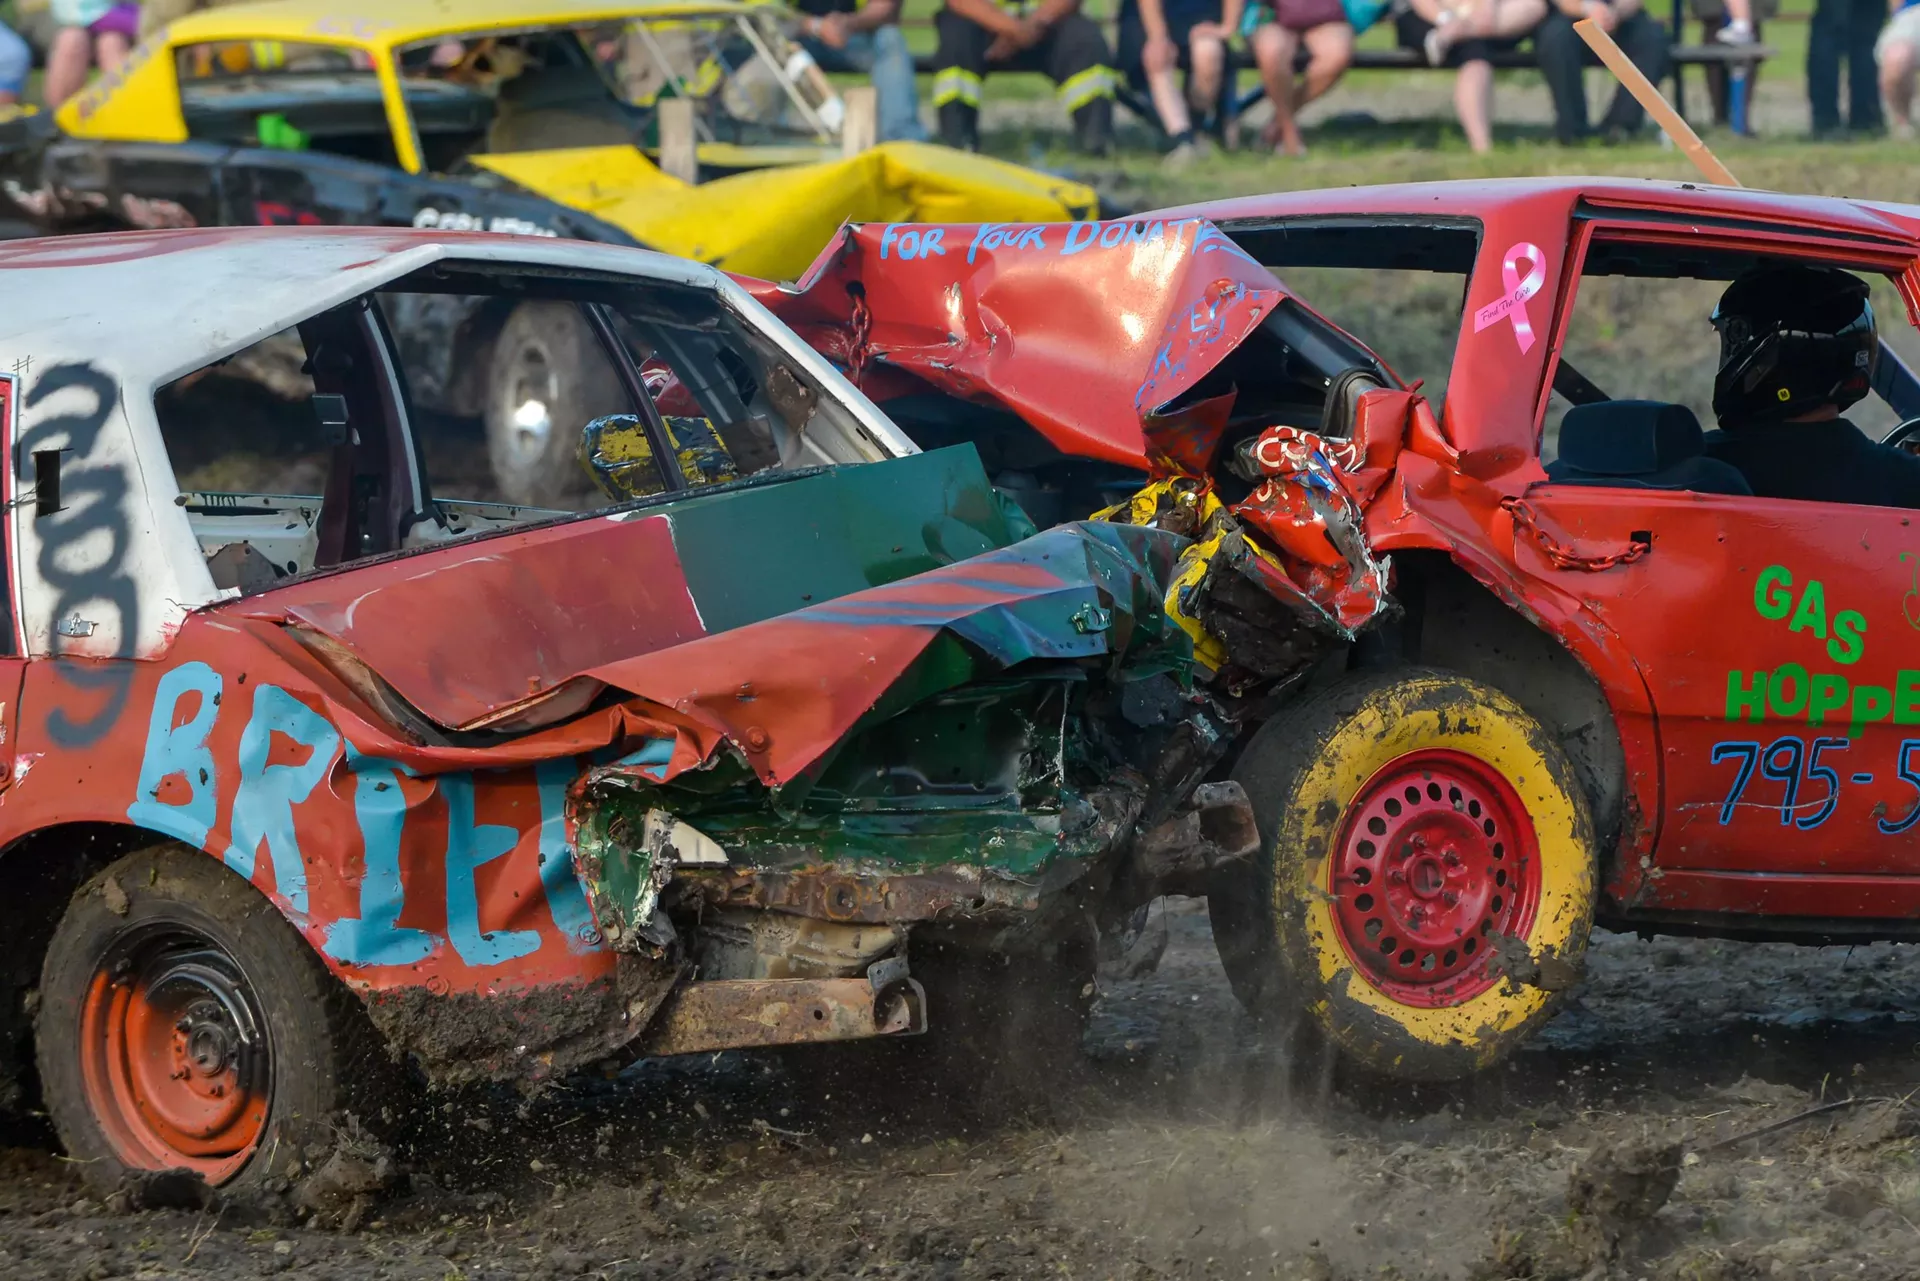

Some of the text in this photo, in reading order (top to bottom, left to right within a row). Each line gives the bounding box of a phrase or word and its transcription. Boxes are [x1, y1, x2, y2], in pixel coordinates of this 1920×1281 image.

[880, 222, 947, 261] FOR
[966, 222, 1047, 266] YOUR
[1480, 286, 1531, 322] Find The Cure
[1754, 564, 1868, 665] GAS
[1724, 662, 1920, 739] HOPPE
[1710, 736, 1920, 834] 795-5
